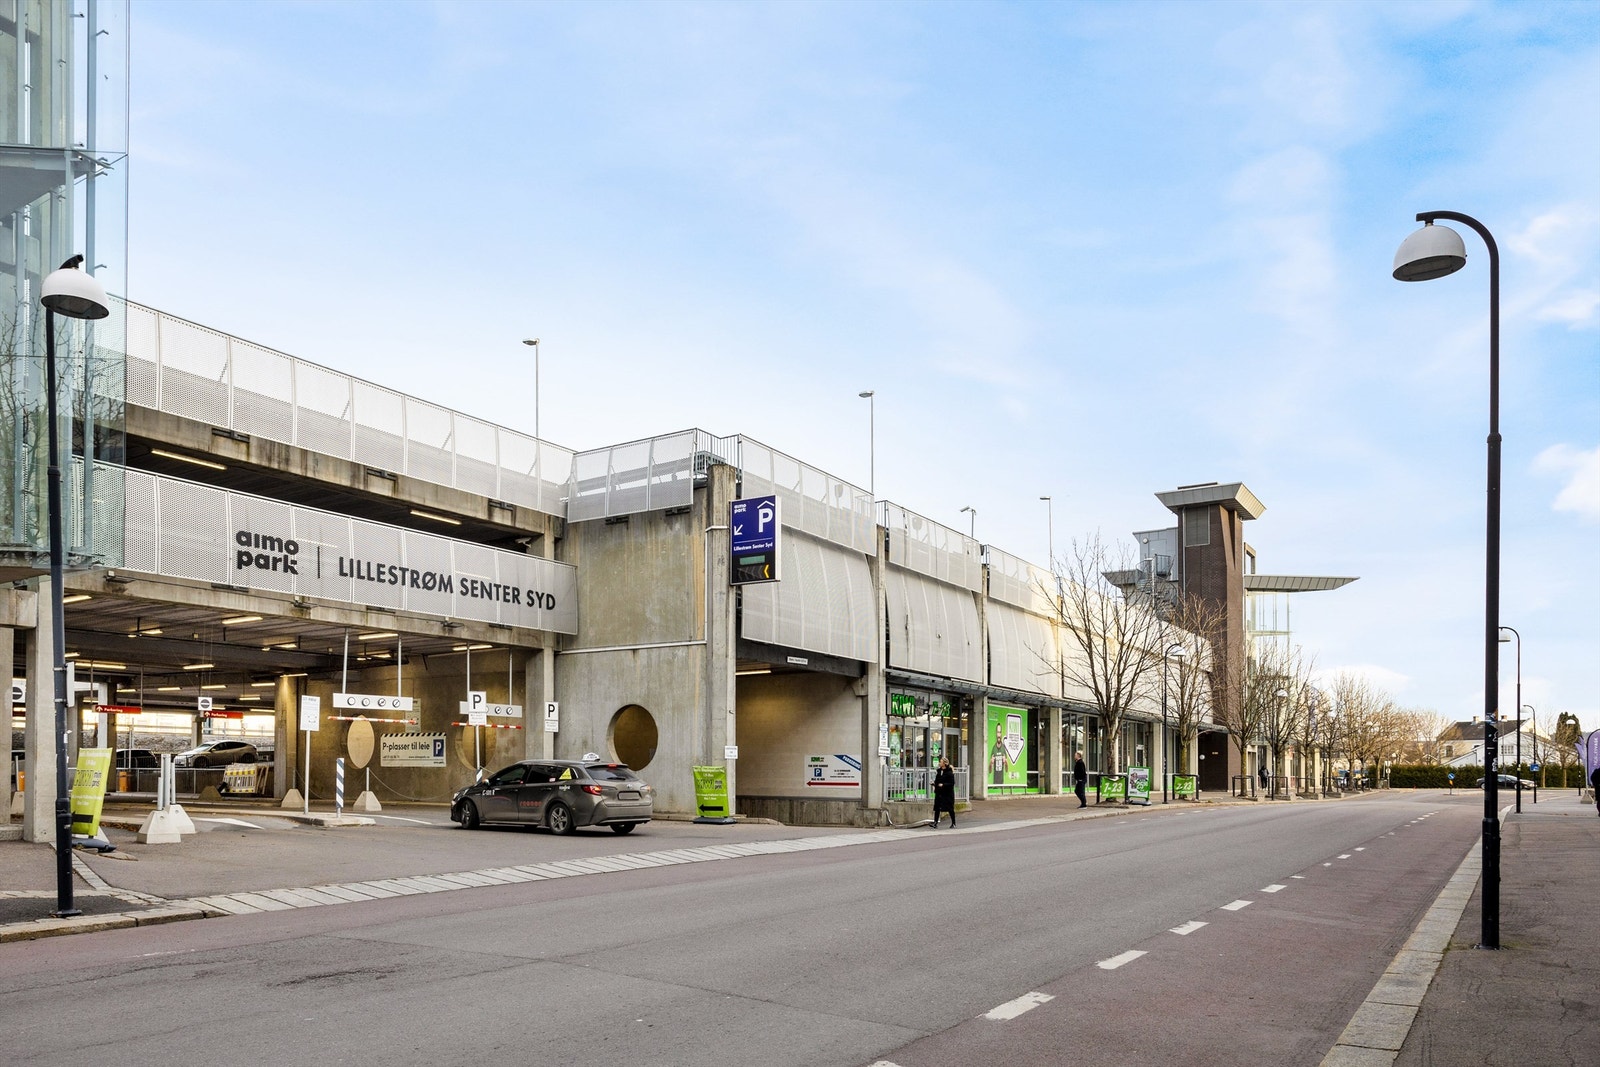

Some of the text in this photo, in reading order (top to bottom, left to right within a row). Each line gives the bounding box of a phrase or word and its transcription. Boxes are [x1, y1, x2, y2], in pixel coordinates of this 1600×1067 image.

[758, 508, 773, 533] P
[236, 530, 300, 555] aimo
[236, 549, 299, 575] park
[339, 556, 556, 611] LILLESTRØM SENTER SYD
[472, 694, 482, 709] P
[547, 704, 556, 718] P
[891, 692, 915, 717] KIWI
[382, 742, 410, 752] P-plasser
[419, 742, 430, 750] leie
[435, 741, 442, 755] P
